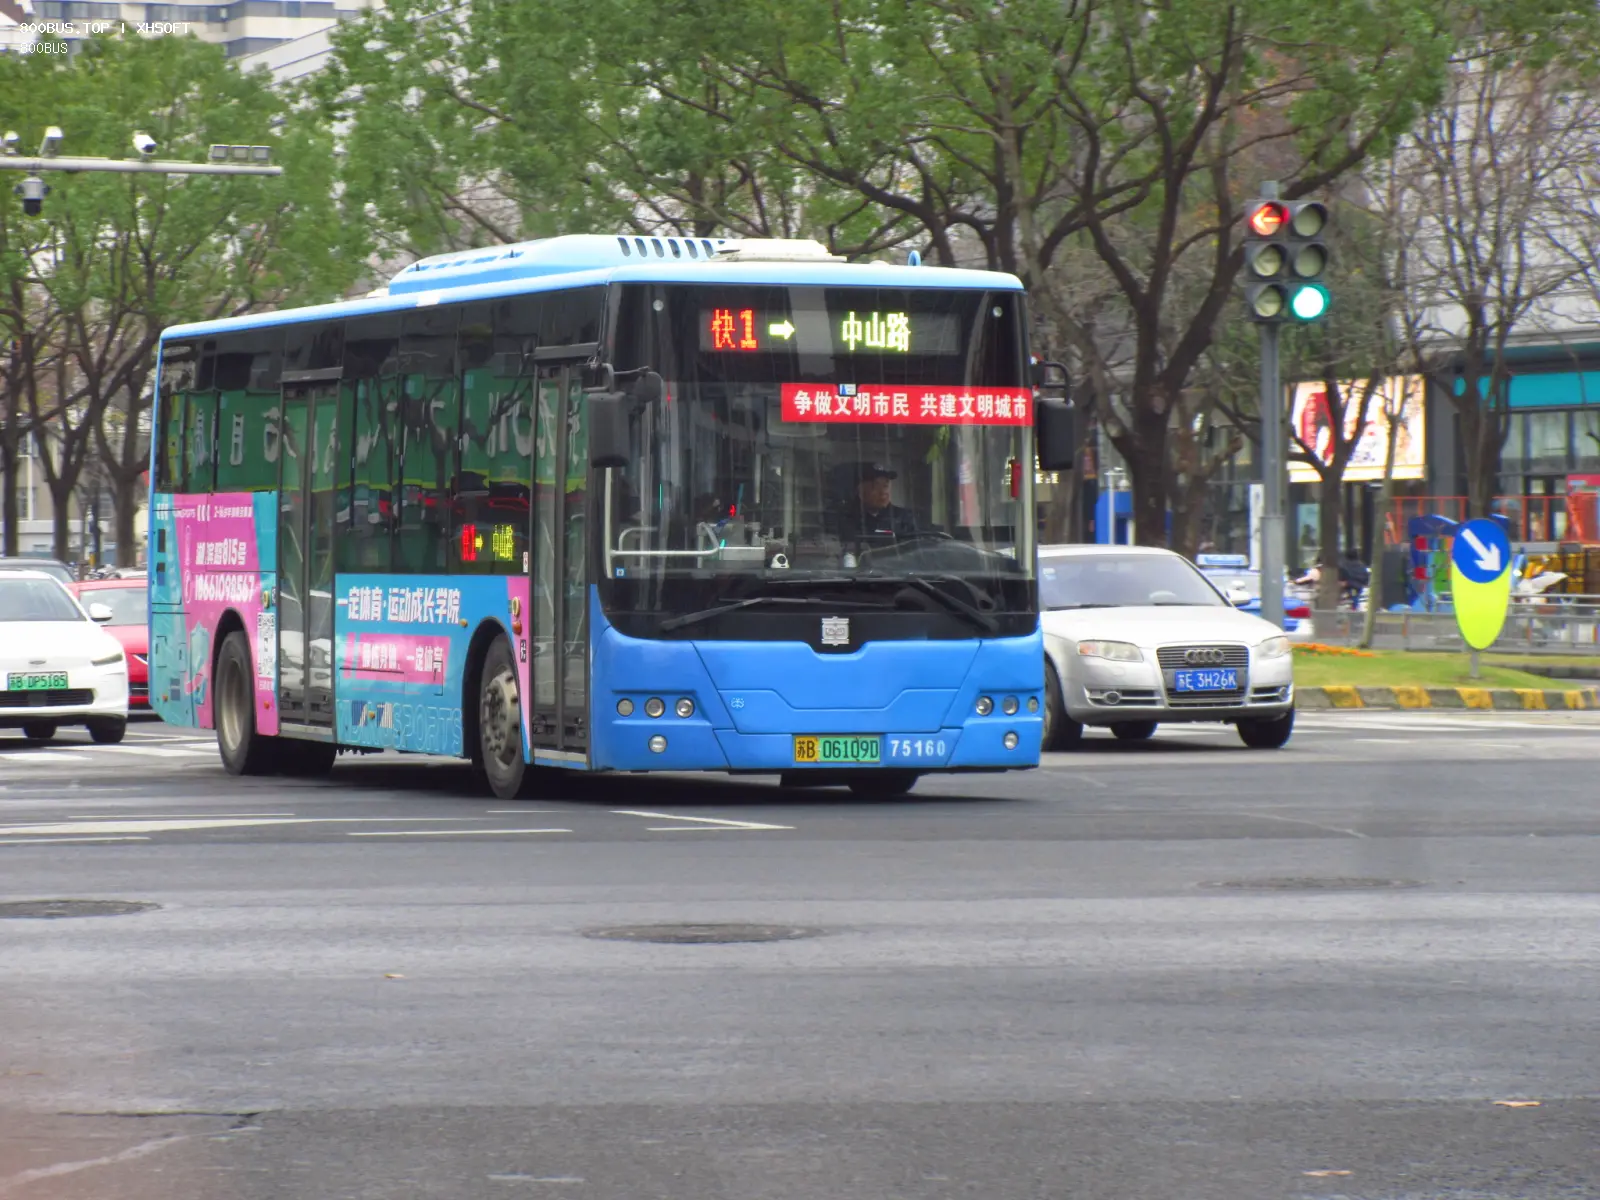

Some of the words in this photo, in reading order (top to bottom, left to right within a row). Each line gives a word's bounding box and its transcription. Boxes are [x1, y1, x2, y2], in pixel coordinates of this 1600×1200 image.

[711, 309, 758, 349] 快1
[842, 310, 911, 352] 中山路
[794, 390, 910, 417] 争做文明市民
[920, 393, 1027, 419] 共建文明城市
[823, 740, 878, 759] 06109D
[890, 740, 946, 757] 75160
